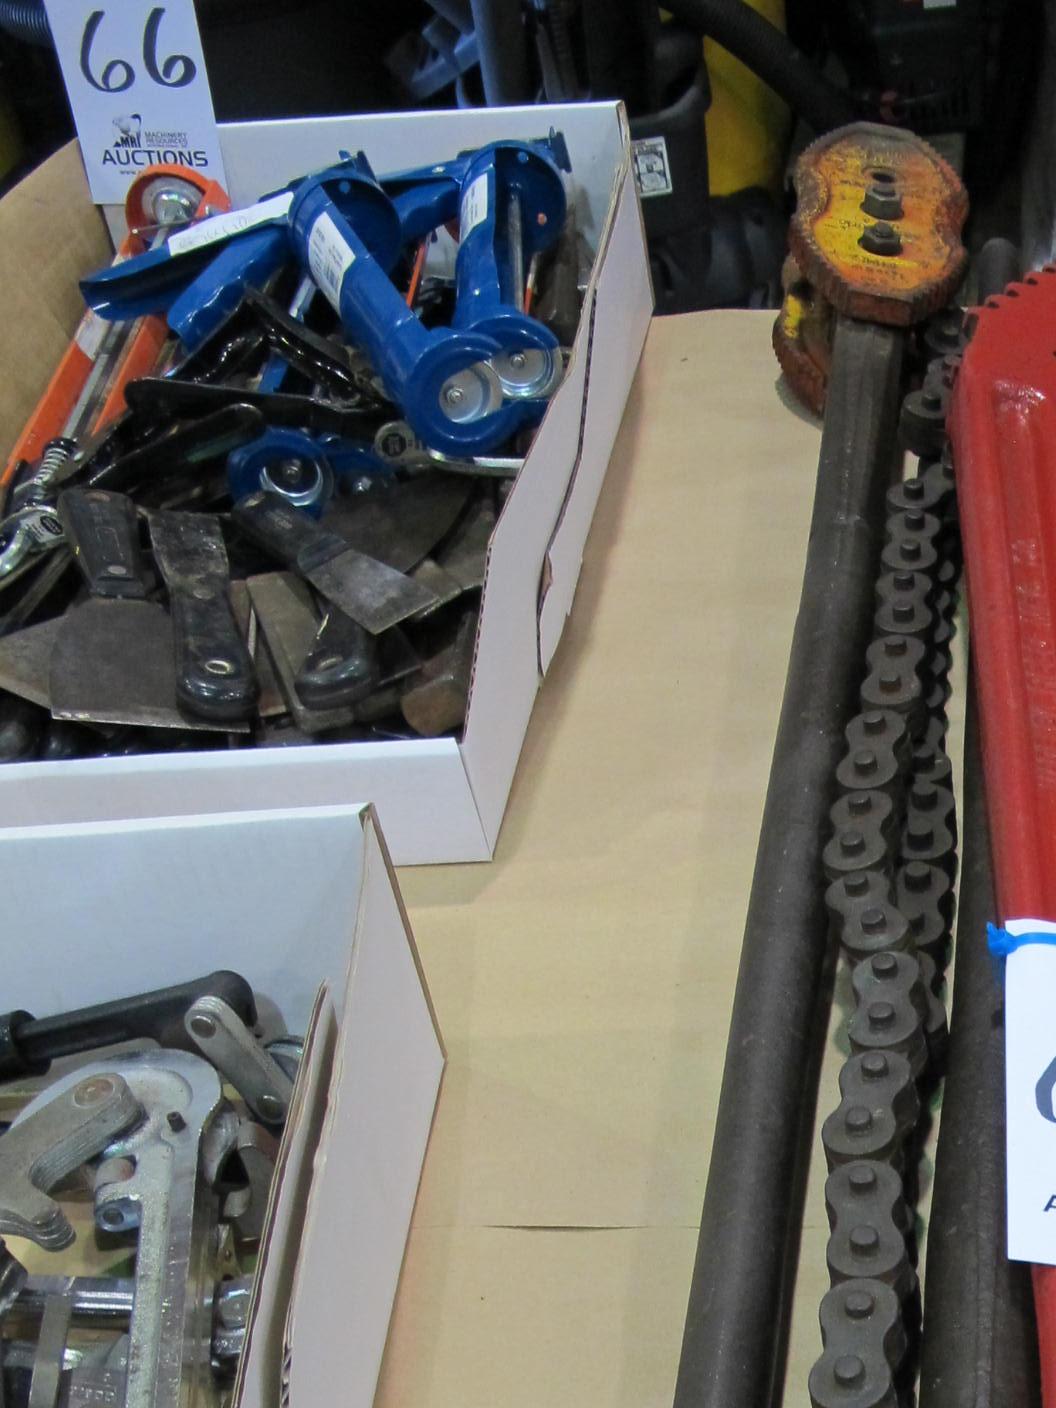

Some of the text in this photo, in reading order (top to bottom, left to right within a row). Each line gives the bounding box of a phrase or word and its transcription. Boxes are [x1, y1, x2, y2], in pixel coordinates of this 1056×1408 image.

[80, 7, 196, 93] 66
[119, 132, 142, 148] MRI
[102, 149, 209, 168] AUCTIONS
